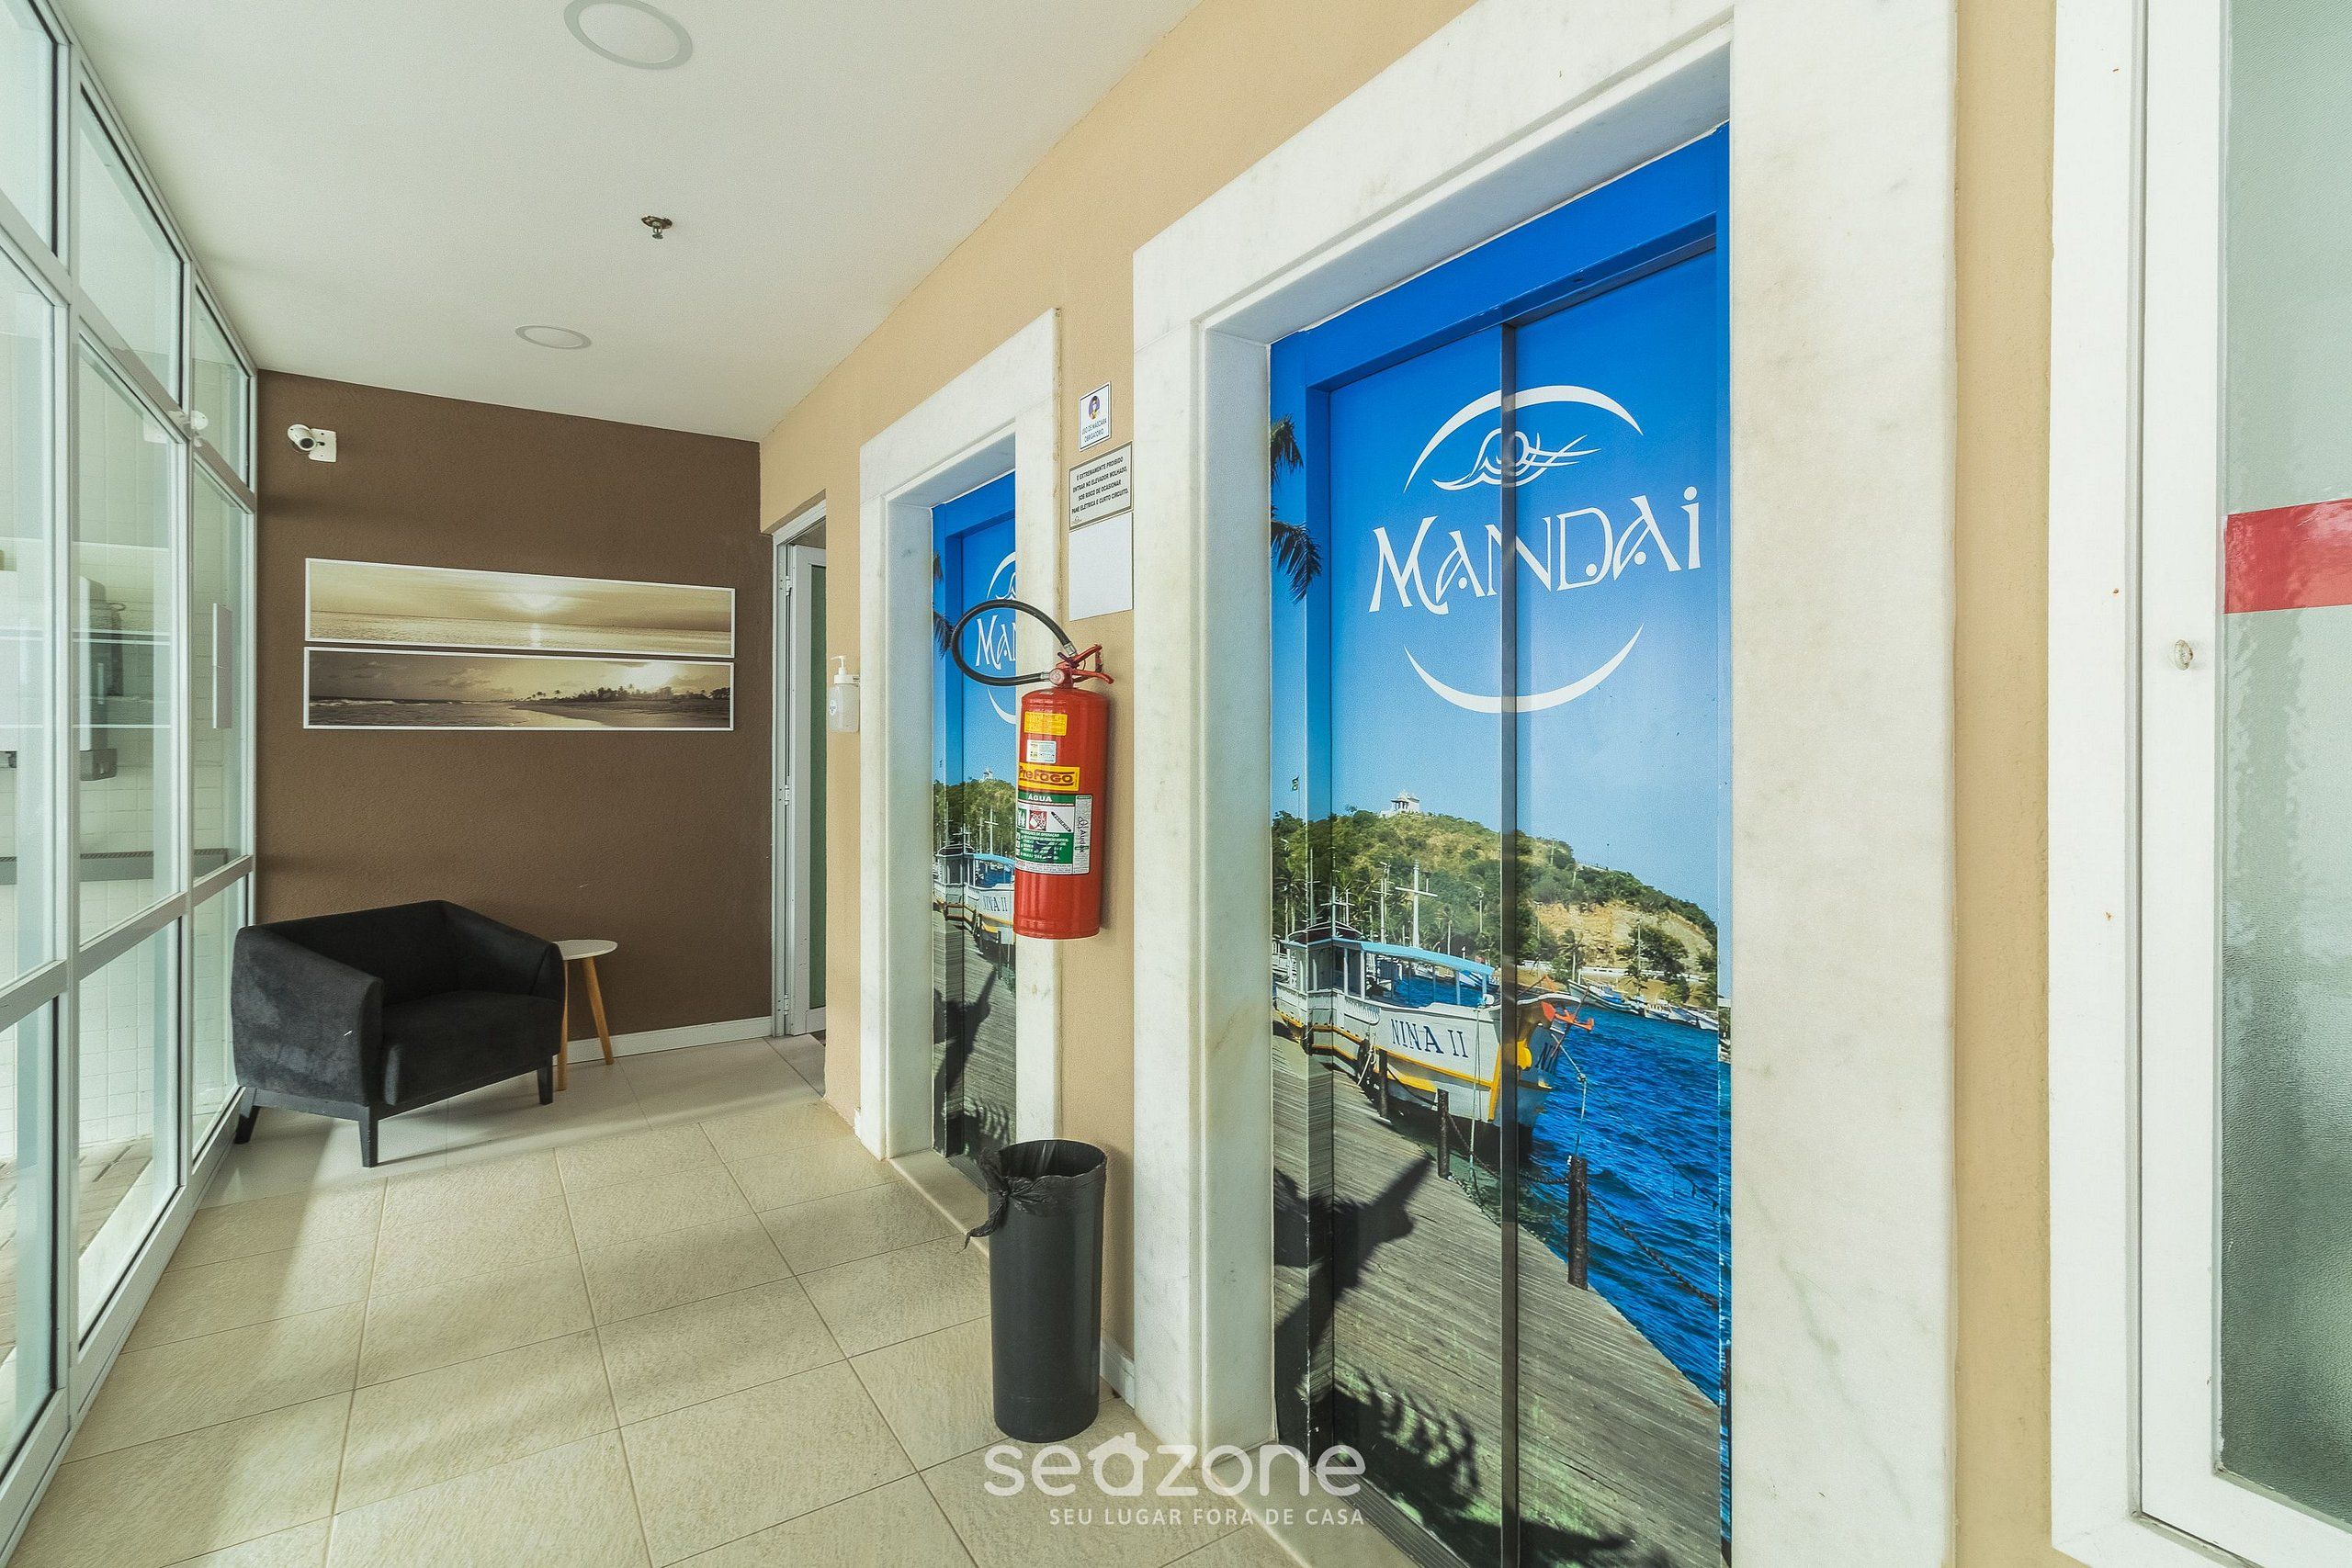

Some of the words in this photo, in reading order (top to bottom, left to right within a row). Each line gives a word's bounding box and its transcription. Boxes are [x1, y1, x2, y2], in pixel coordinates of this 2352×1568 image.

[1106, 457, 1124, 468] PROIBIDO
[1072, 482, 1085, 493] ENTRAR
[1091, 473, 1109, 486] ELEVADOR
[1085, 489, 1096, 499] RISCO
[1071, 505, 1080, 514] PANE
[1099, 494, 1112, 504] CURTO
[1028, 793, 1053, 803] ÁGUA
[1390, 1018, 1444, 1055] NINA
[1447, 1029, 1469, 1058] II
